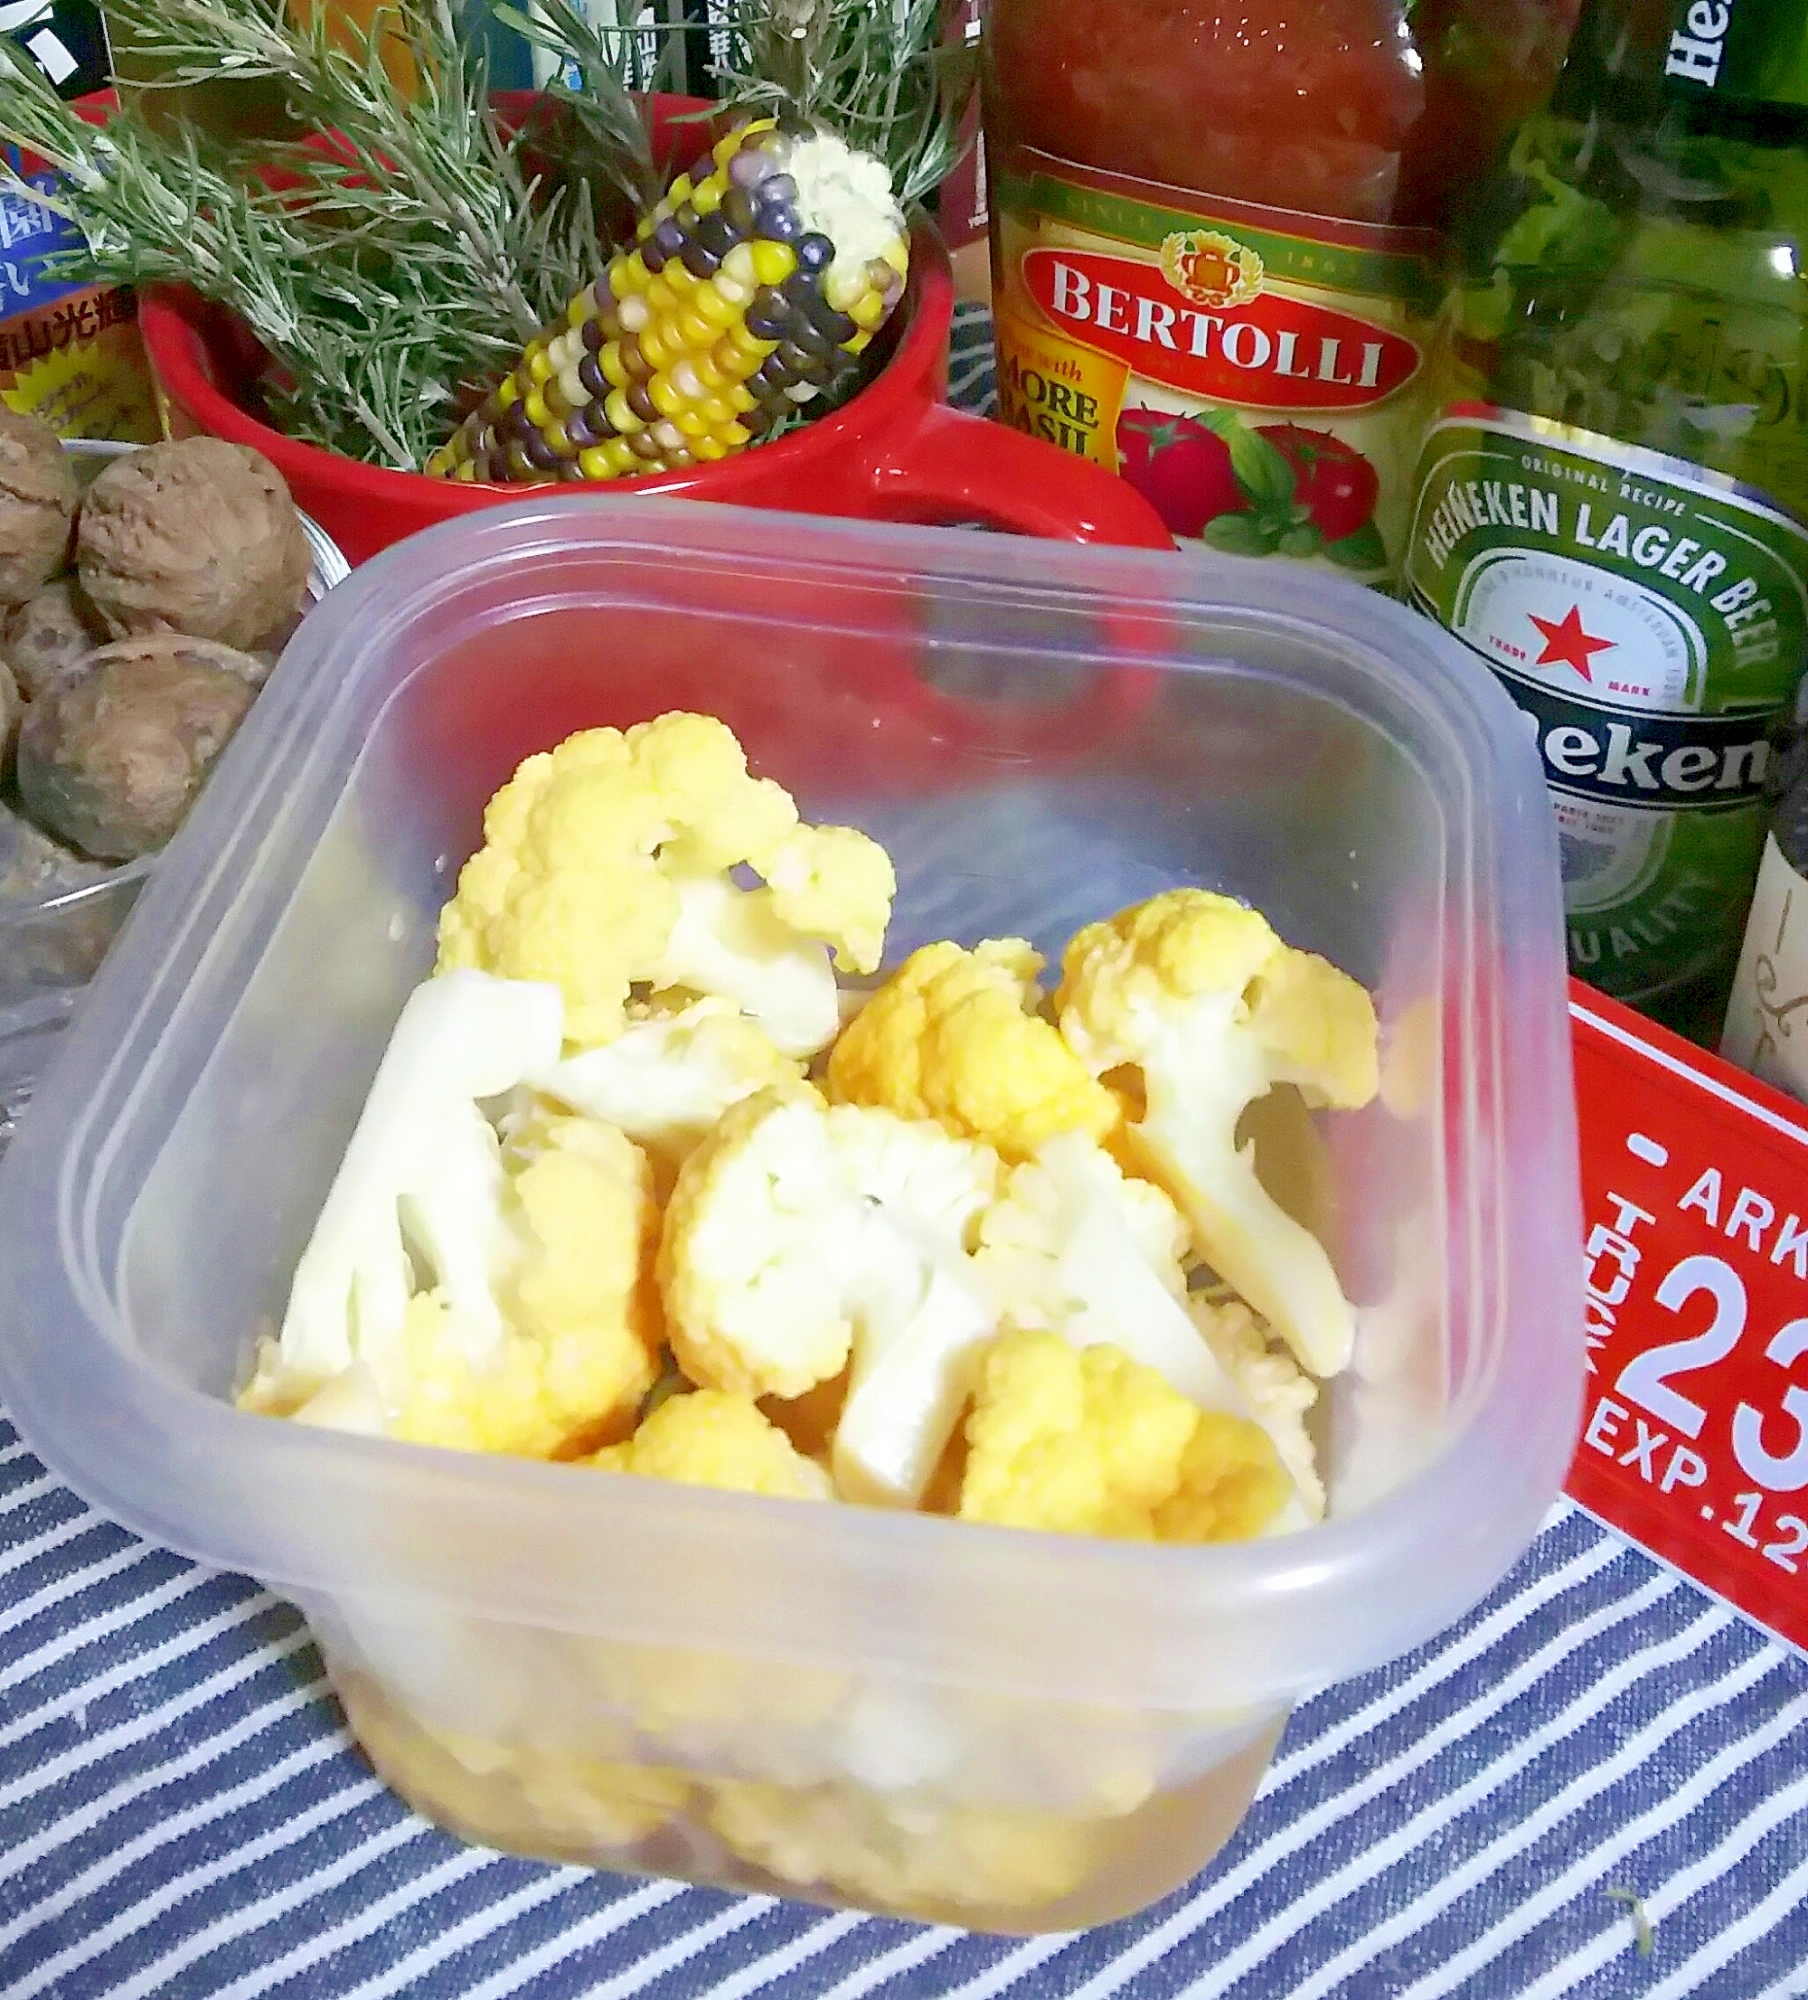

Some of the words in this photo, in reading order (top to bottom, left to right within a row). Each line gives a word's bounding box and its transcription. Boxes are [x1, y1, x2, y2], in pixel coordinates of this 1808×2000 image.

[1666, 0, 1733, 88] He
[1052, 261, 1384, 388] BERTOLLI
[1521, 454, 1608, 493] ORIGINAL
[1619, 483, 1686, 517] RECIPE
[1424, 480, 1559, 570] HEINEKEN
[1575, 502, 1727, 595] LAGER
[1709, 577, 1780, 668] BEER
[1607, 680, 1651, 698] MARK
[1544, 716, 1771, 793] eken
[1677, 1167, 1808, 1280] ARK
[1614, 1253, 1808, 1492] 23
